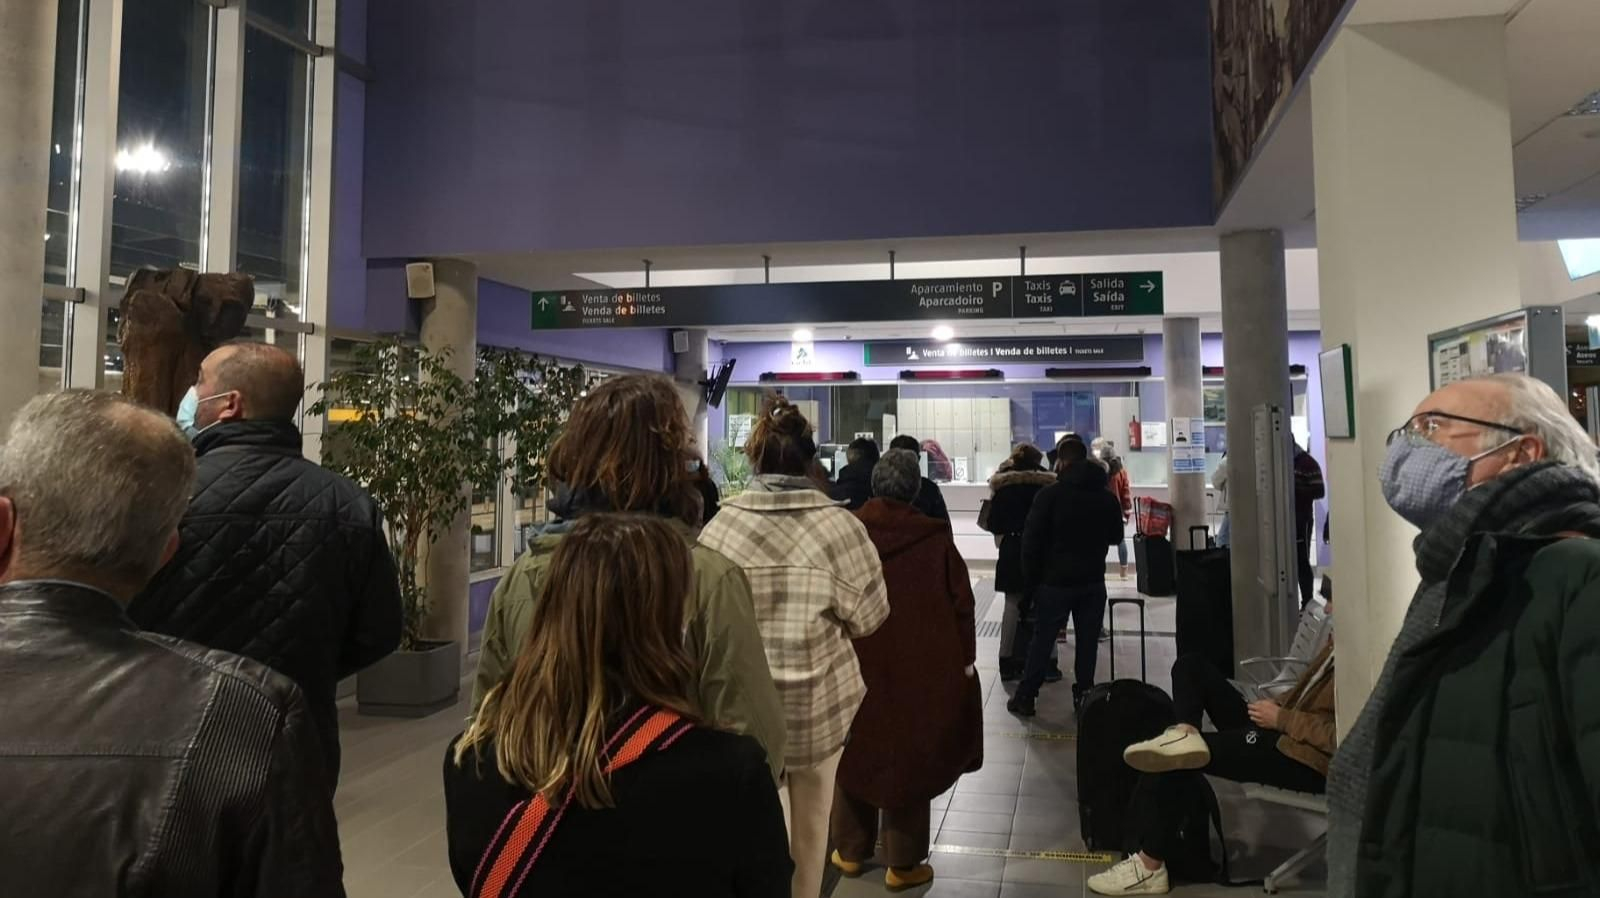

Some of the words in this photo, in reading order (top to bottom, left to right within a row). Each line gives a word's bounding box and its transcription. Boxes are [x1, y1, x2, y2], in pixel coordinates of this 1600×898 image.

[911, 282, 983, 296] Aparcamiento
[992, 281, 1003, 298] P
[1025, 280, 1051, 291] Taxis
[1090, 278, 1125, 289] Salida
[582, 294, 609, 304] Venta
[612, 293, 624, 304] de
[626, 292, 661, 303] billetes
[919, 295, 983, 308] Aparcadoiro
[1025, 293, 1053, 304] Taxis
[1093, 290, 1125, 302] Saída
[582, 305, 612, 316] Venda
[615, 305, 627, 316] de
[630, 304, 666, 315] billetes
[1040, 305, 1053, 313] TAXI
[923, 348, 945, 358] Venta
[960, 347, 989, 357] billetes
[995, 346, 1021, 356] Venda
[1024, 346, 1034, 356] de
[1037, 345, 1067, 355] billetes
